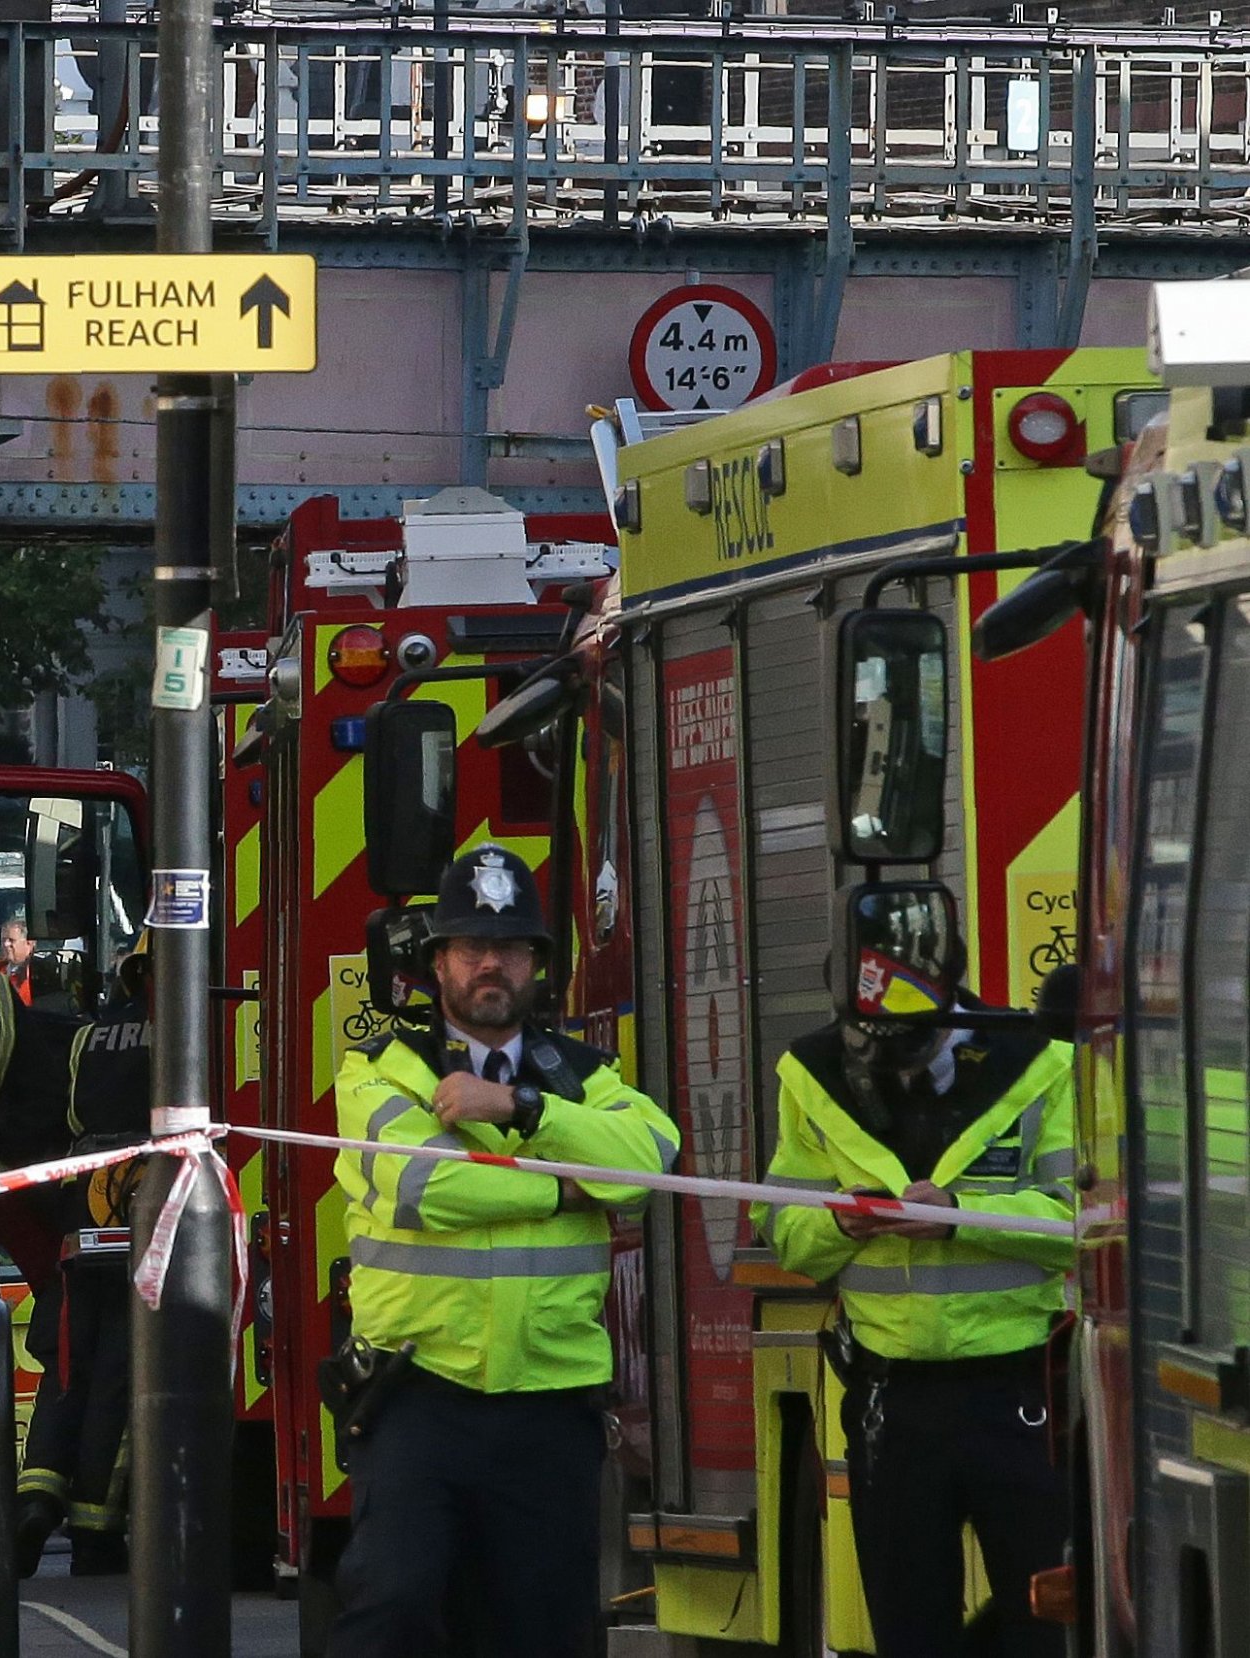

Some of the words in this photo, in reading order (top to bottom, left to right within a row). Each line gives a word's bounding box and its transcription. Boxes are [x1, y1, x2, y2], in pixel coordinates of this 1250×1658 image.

[68, 280, 216, 309] FULHAM
[85, 319, 198, 347] REACH
[659, 321, 717, 352] 4.4
[723, 333, 749, 352] m
